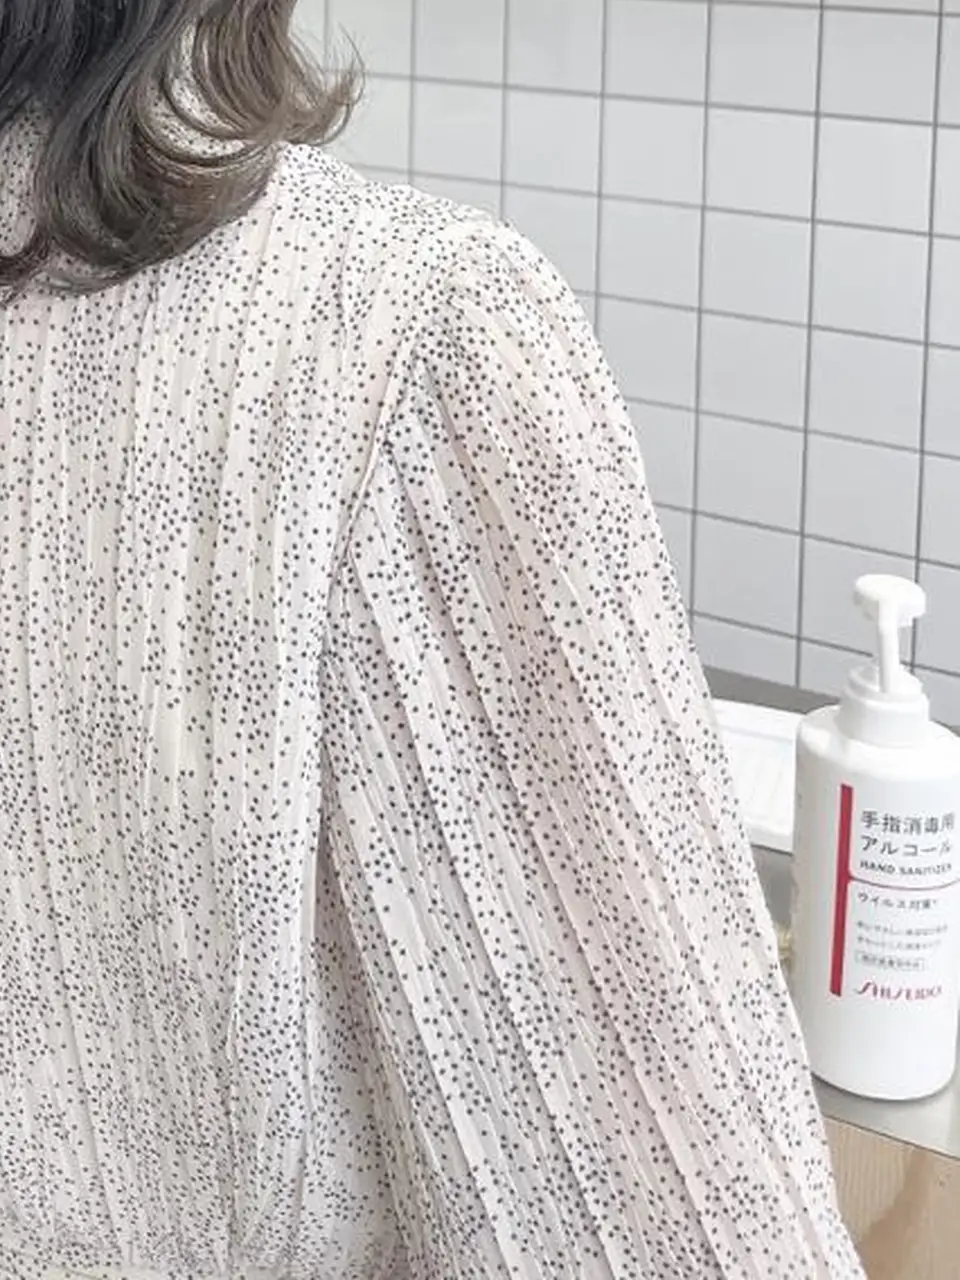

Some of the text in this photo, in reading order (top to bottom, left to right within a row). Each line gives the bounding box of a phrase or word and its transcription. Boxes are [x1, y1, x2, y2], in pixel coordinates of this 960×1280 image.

[860, 810, 955, 836] 手指消毒用
[860, 835, 952, 857] アルコール
[860, 860, 895, 875] HAND
